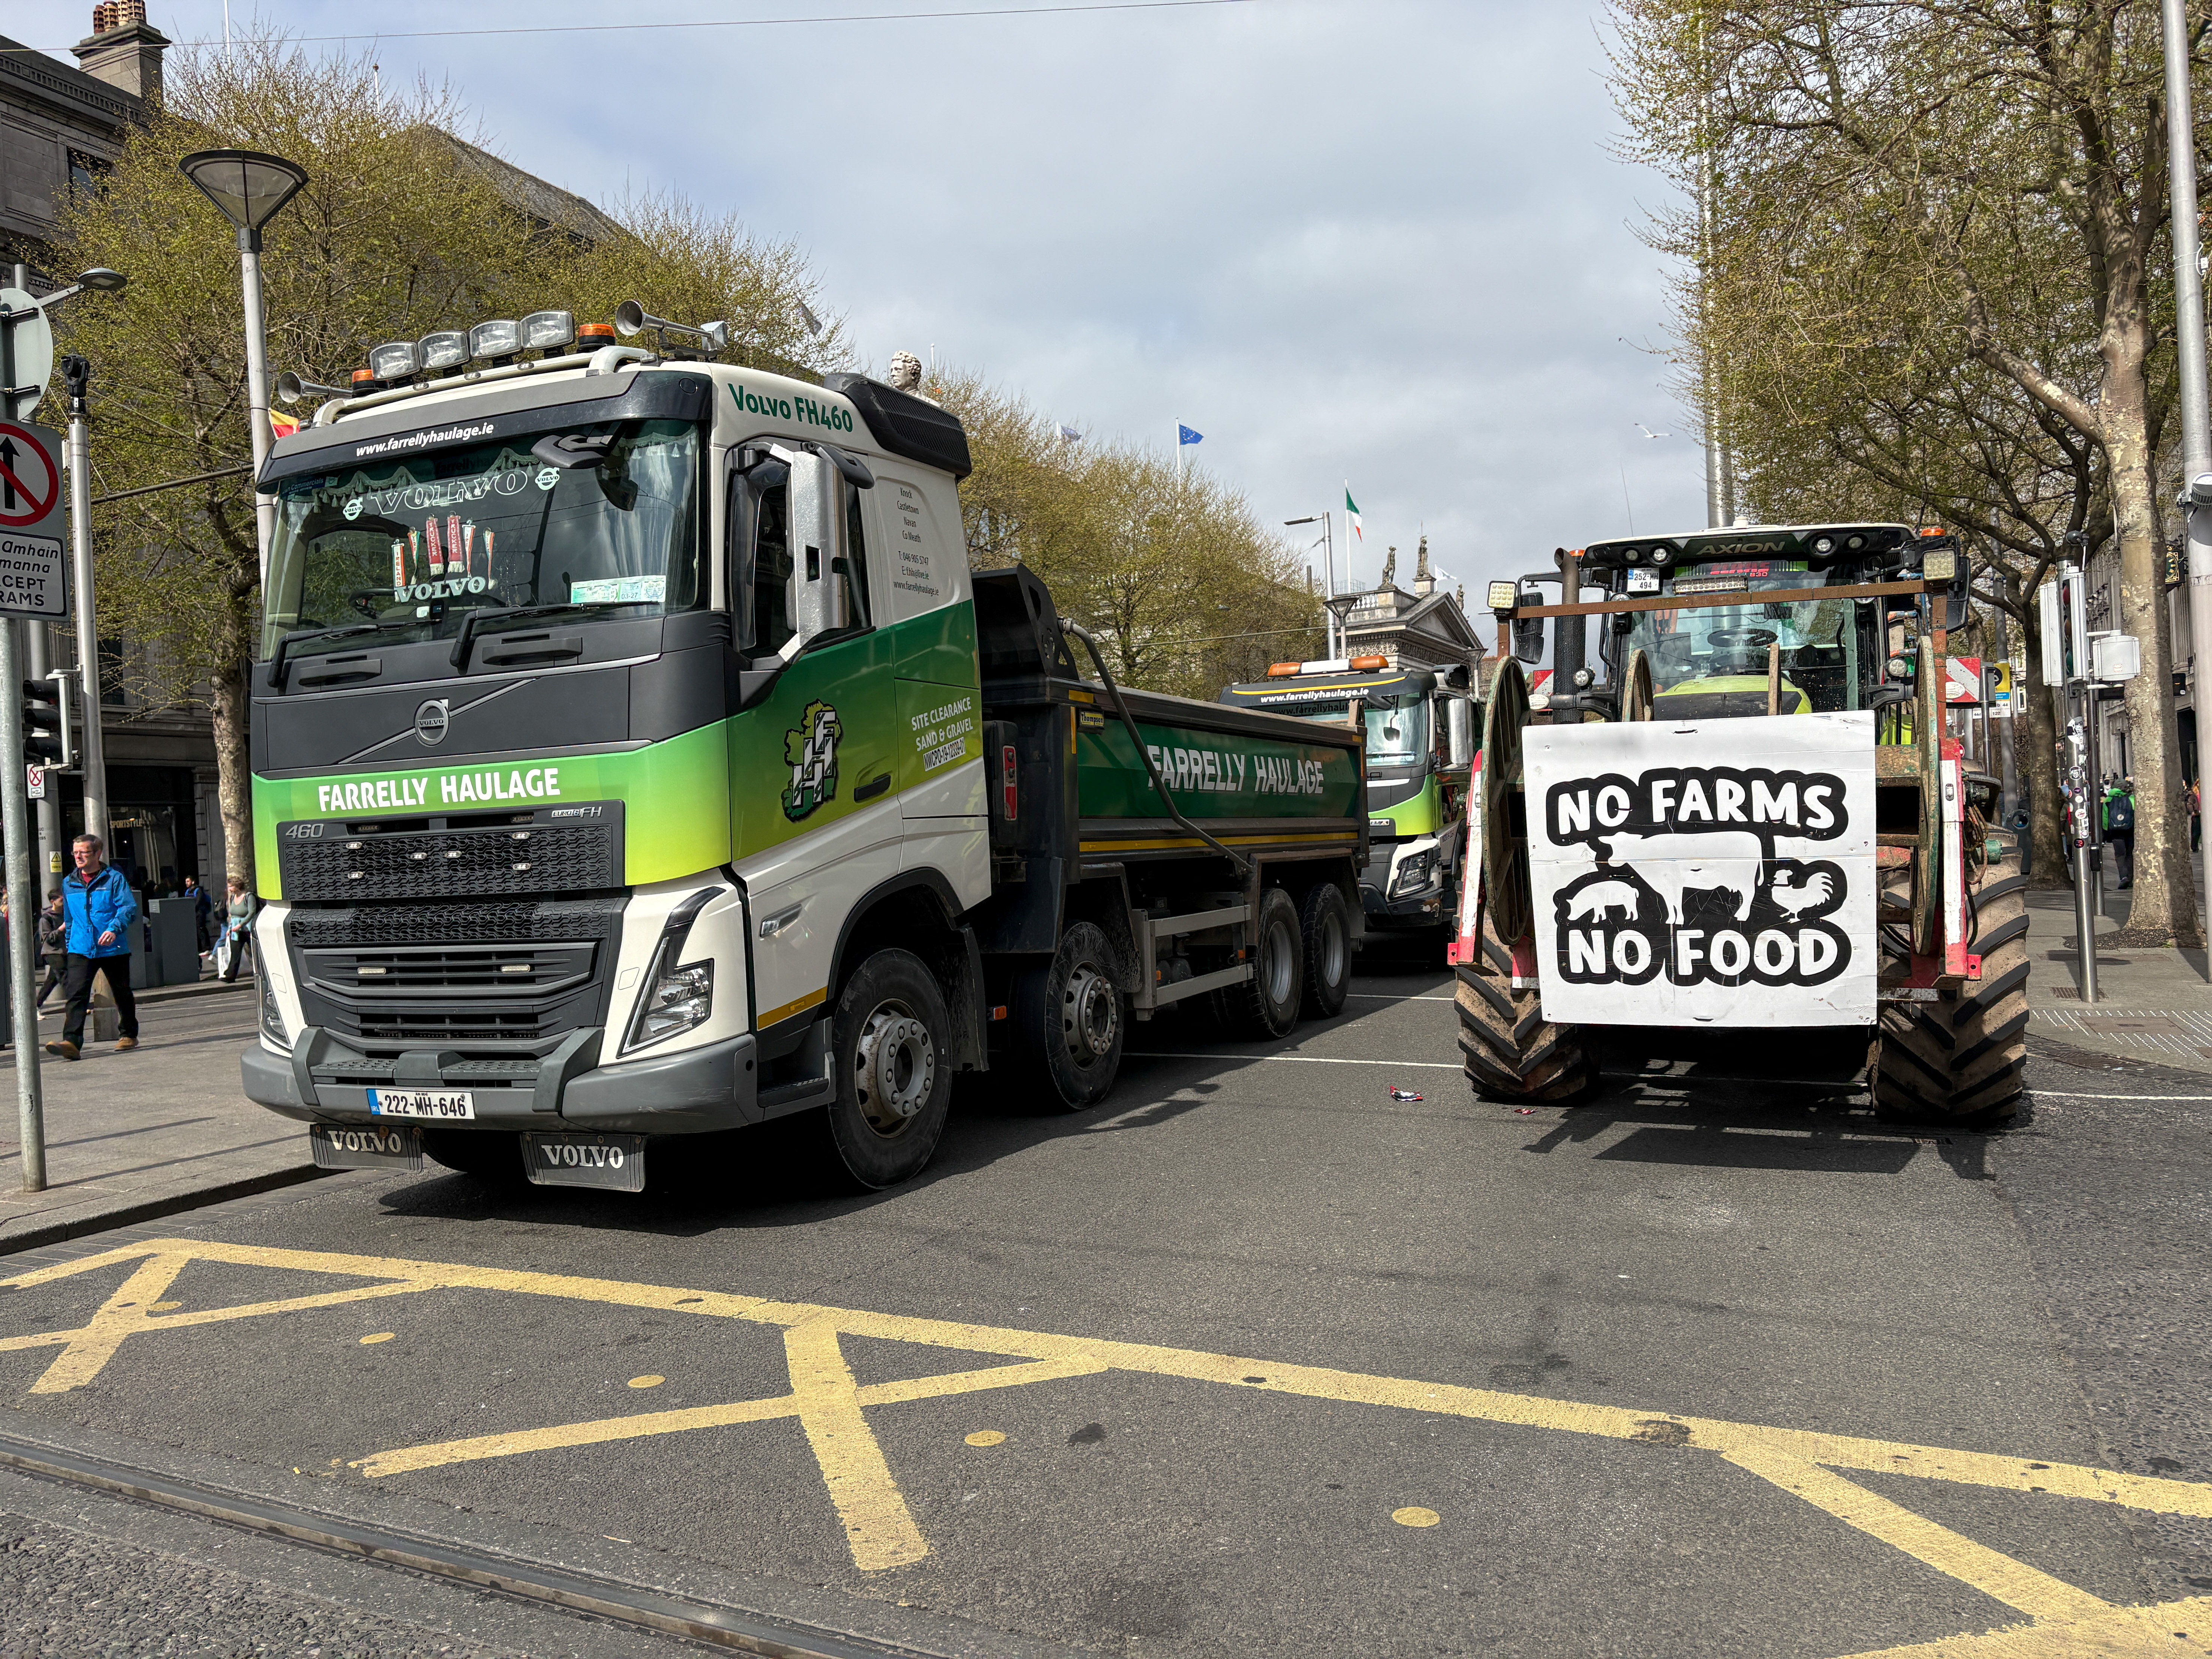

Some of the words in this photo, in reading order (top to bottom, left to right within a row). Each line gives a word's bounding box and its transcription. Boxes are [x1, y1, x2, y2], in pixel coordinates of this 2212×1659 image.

[794, 397, 853, 432] FH460
[356, 423, 494, 457] www.farrellyhaulage.ie
[371, 470, 528, 514] VOLVO
[900, 487, 912, 499] Knock
[897, 501, 919, 514] Castletown
[904, 517, 916, 527] Navan
[429, 523, 437, 556] TRUCKER
[902, 531, 907, 539] Co
[908, 532, 921, 543] Meath
[1696, 542, 1785, 555] AXION
[0, 575, 45, 590] CEPT
[394, 577, 486, 602] VOLVO
[893, 581, 939, 596] www.farrellyhaulage.ie
[1260, 688, 1369, 703] www.farrellyhaulage.ie
[418, 718, 444, 727] VOLVO
[911, 713, 929, 731] SITE
[930, 697, 971, 724] CLEARANCE
[1081, 712, 1103, 725] Thompson
[916, 731, 937, 751] SAND
[939, 729, 945, 742] &
[946, 718, 973, 739] GRAVEL
[1147, 745, 1245, 792] FARRELLY
[1254, 755, 1323, 794] HAULAGE
[319, 777, 428, 812] FARRELLY
[441, 768, 560, 803] HAULAGE
[580, 806, 602, 818] FH
[1558, 785, 1632, 835] NO
[1651, 778, 1836, 829] FARMS
[286, 824, 324, 838] 460
[1569, 929, 1651, 976] NO
[1676, 928, 1838, 976] FOOD
[385, 1095, 466, 1116] 222-MH-646
[327, 1130, 401, 1154] VOLVO
[541, 1144, 624, 1169] VOLVO
